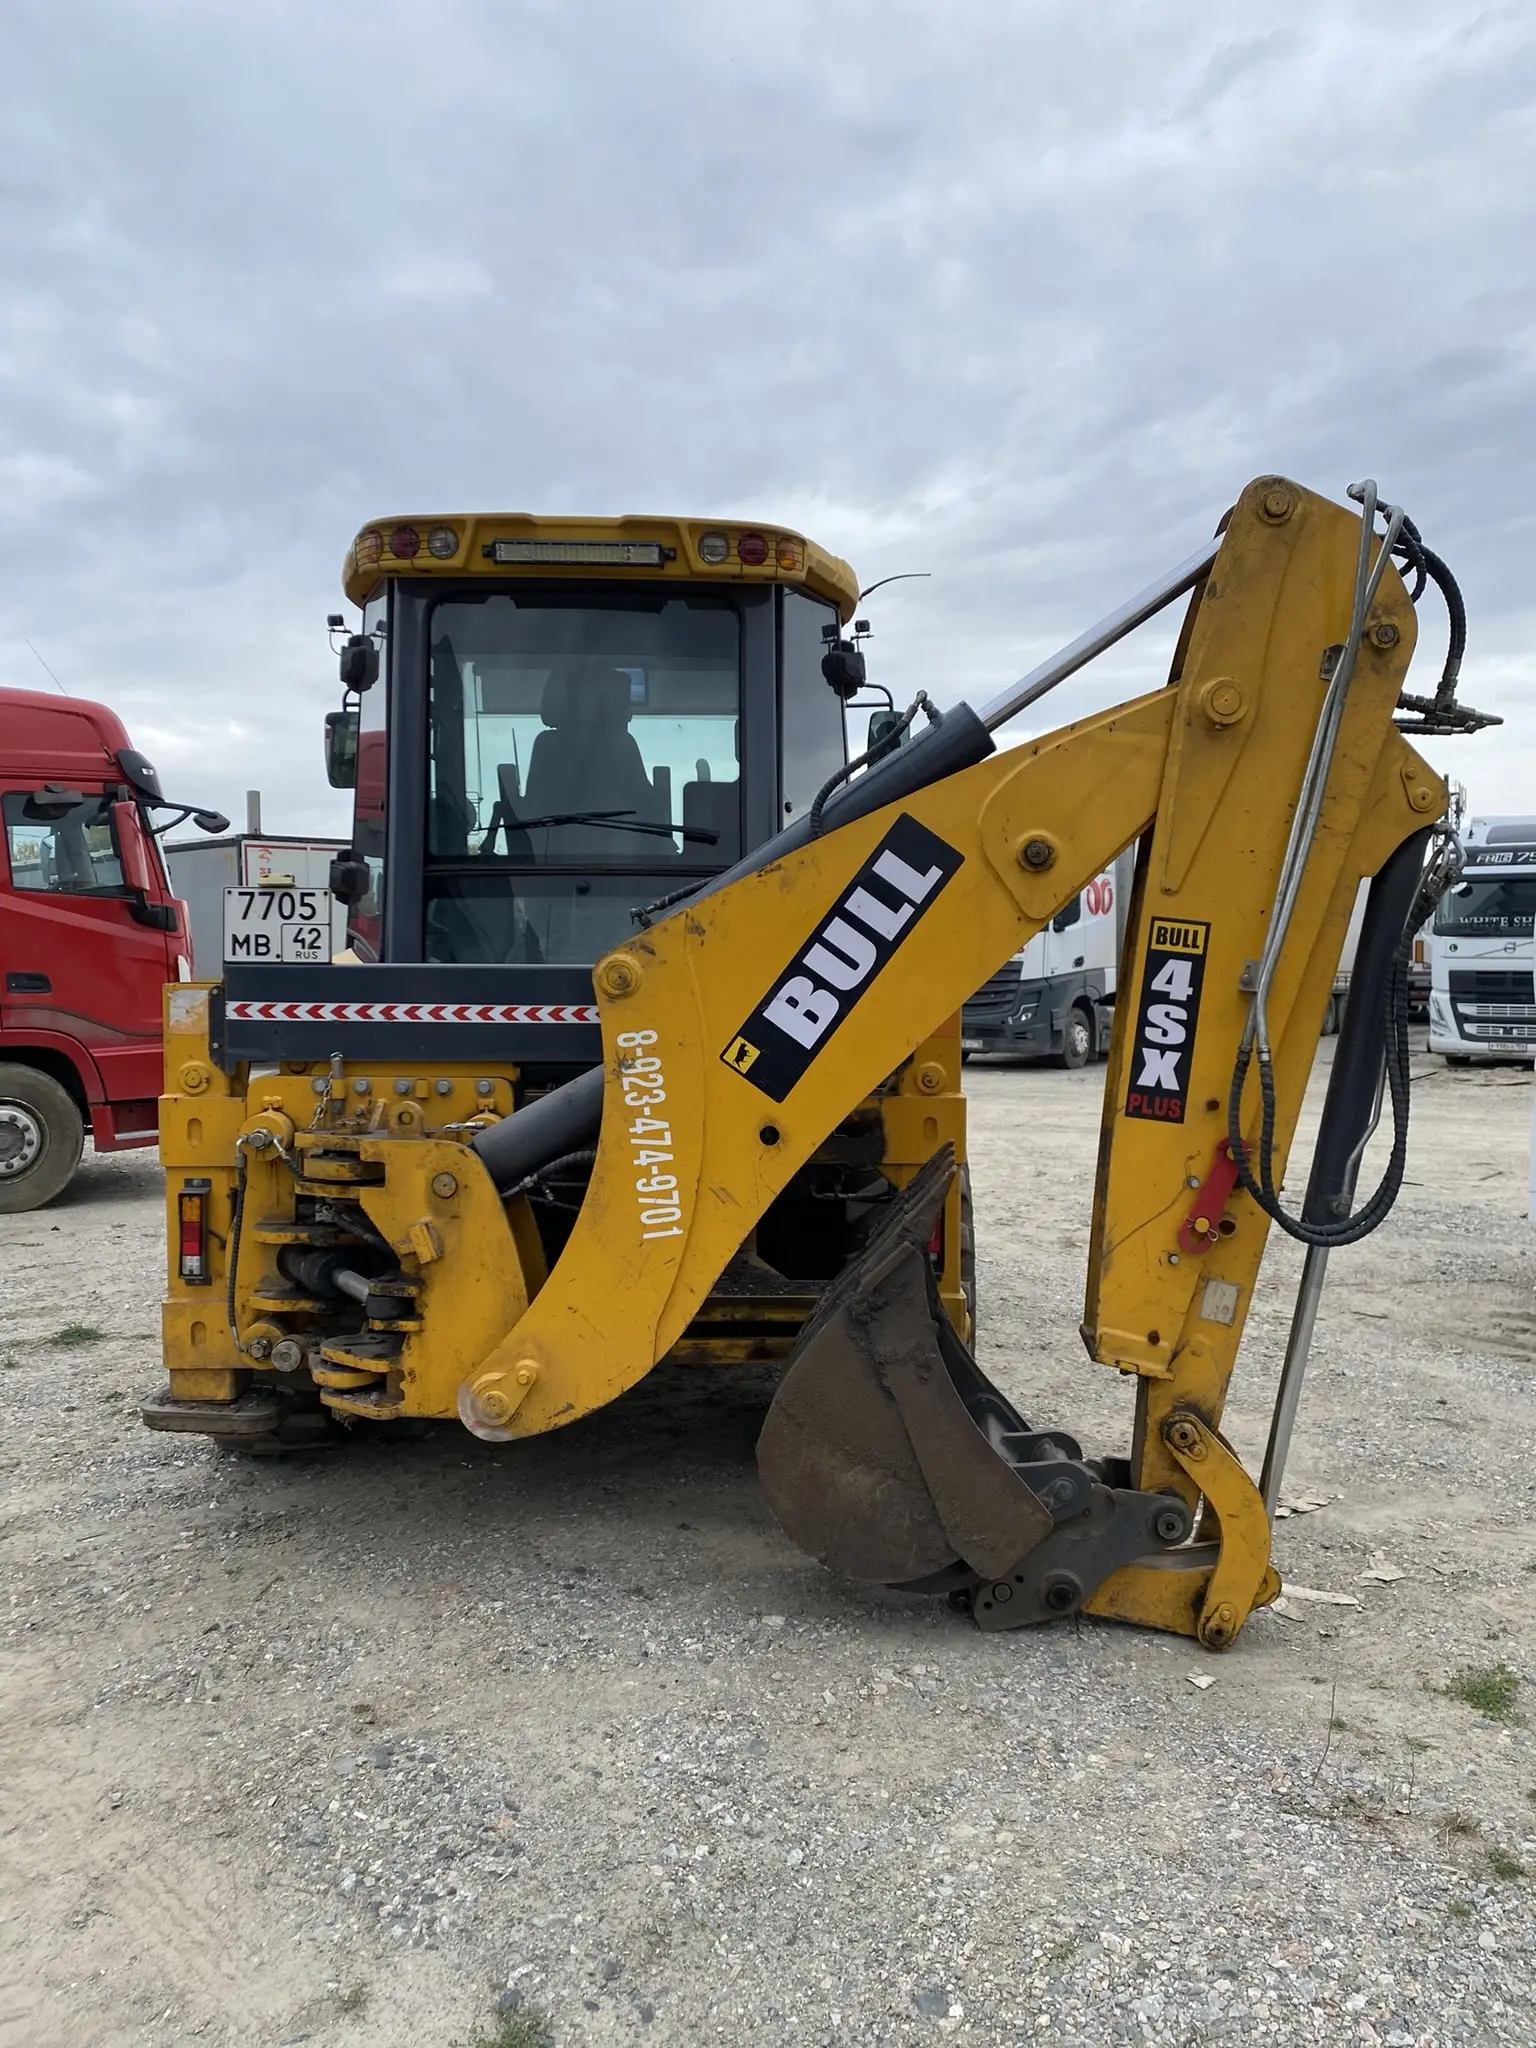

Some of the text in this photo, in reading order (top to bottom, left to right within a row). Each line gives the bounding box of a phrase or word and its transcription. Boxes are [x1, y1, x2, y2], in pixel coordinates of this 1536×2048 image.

[238, 891, 317, 921] 7705
[1460, 916, 1509, 927] WHITE
[231, 933, 271, 956] MB
[293, 927, 321, 949] 42
[1155, 926, 1200, 949] BULL
[295, 950, 318, 960] RUS
[762, 849, 944, 1050] BULL
[1128, 1093, 1181, 1118] PLUS
[616, 1029, 684, 1240] 8-923-474-9701
